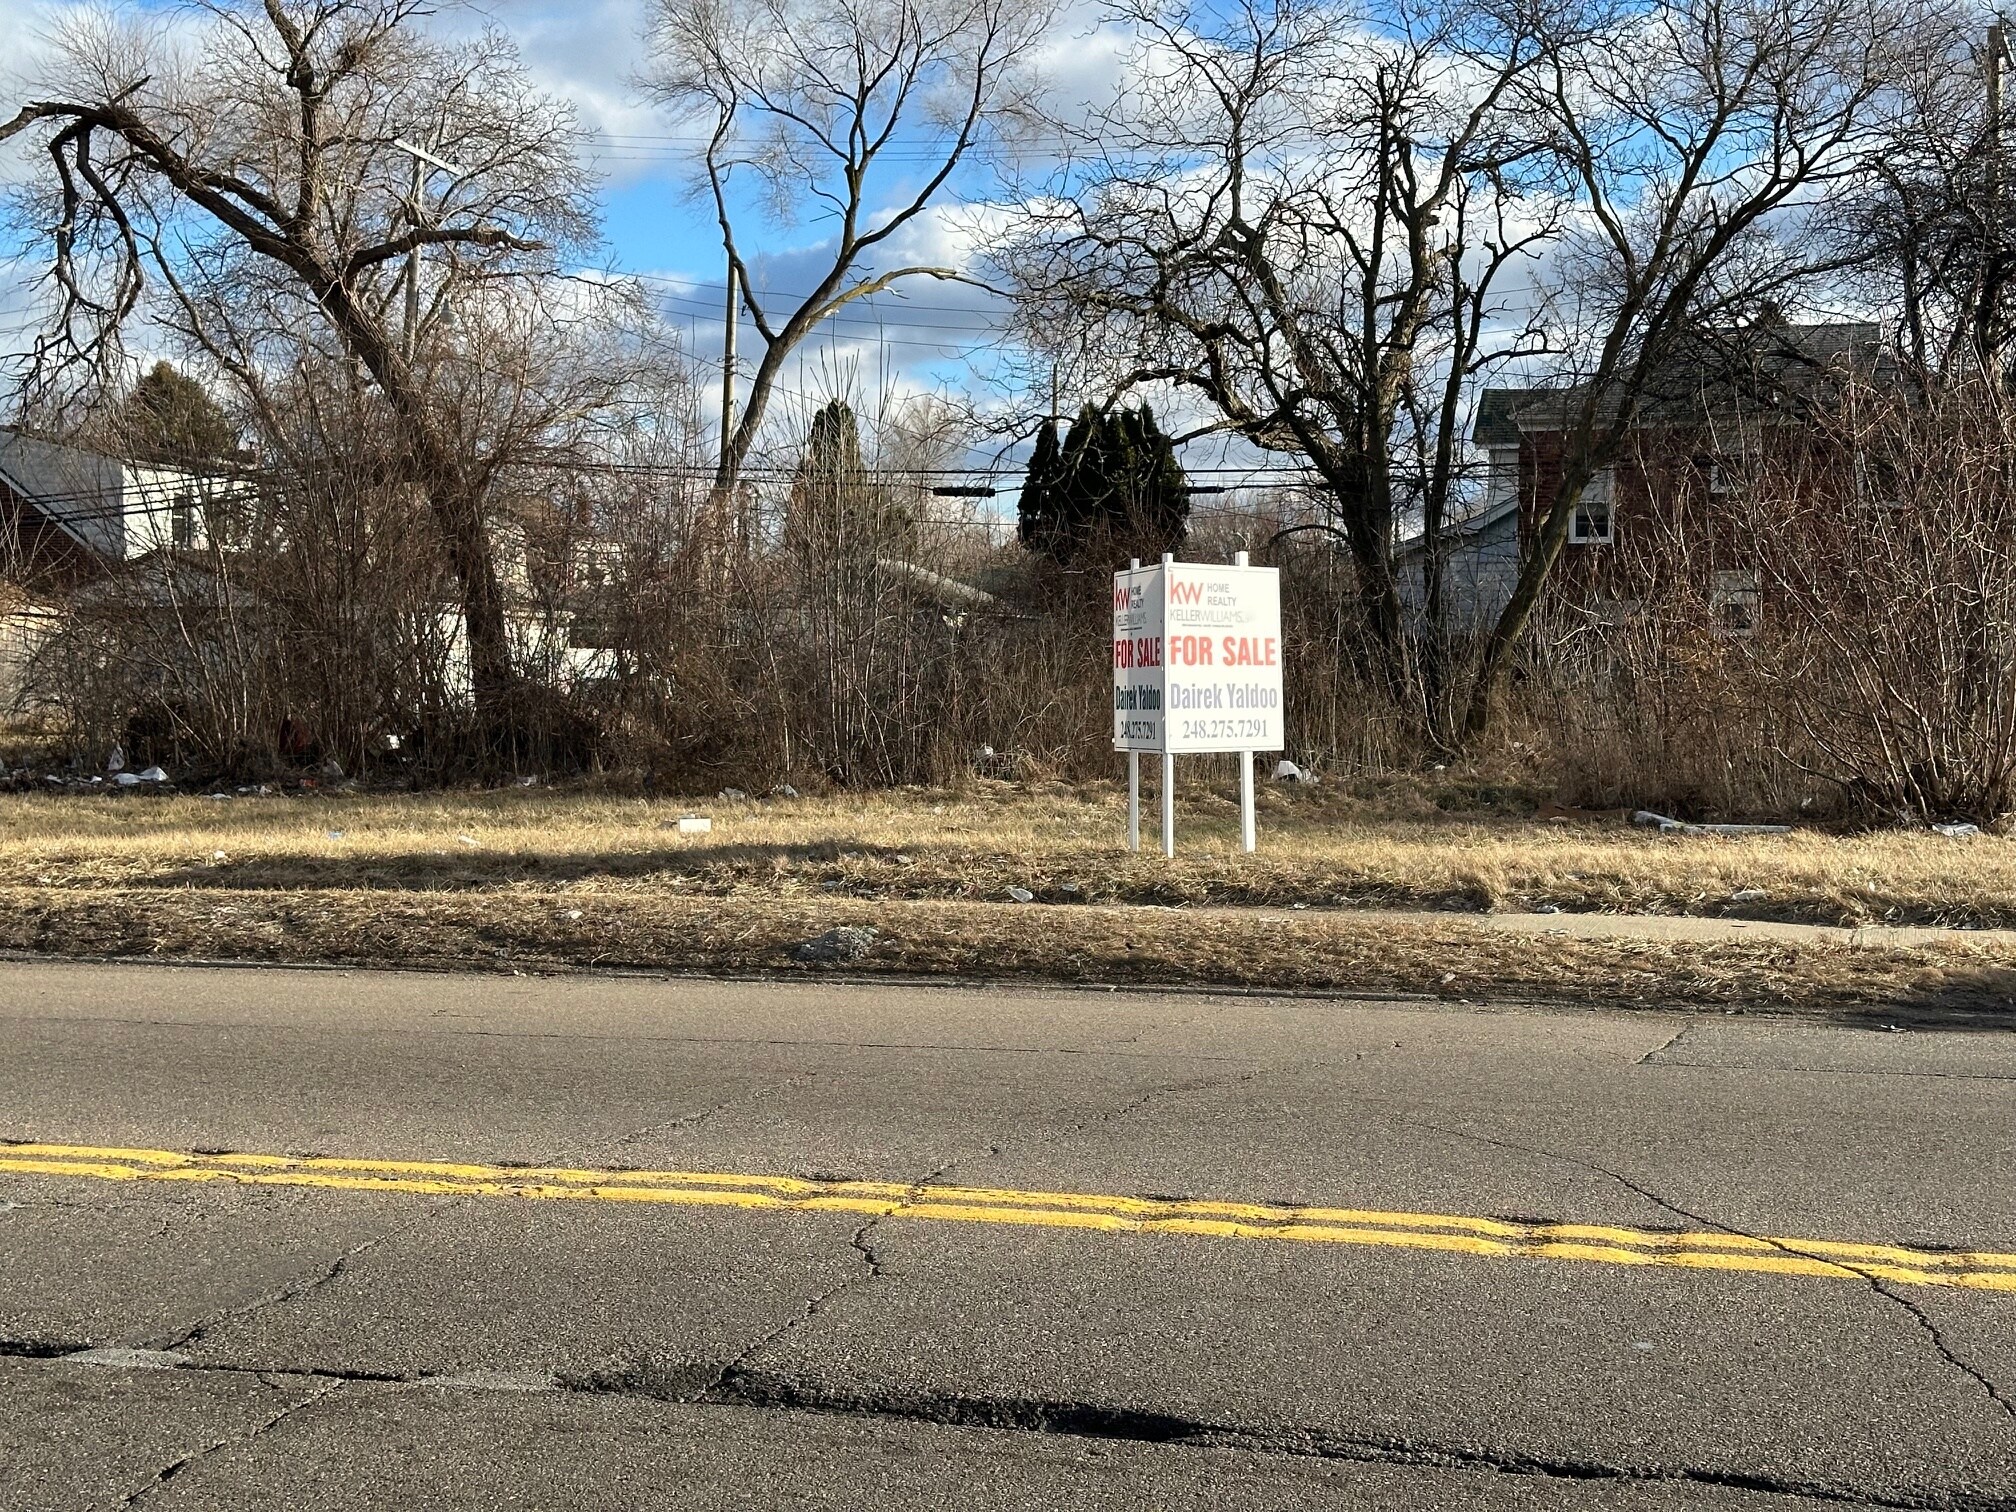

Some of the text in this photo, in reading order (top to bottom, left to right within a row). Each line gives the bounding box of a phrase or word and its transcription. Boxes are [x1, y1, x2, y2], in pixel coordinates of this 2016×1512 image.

[1207, 583, 1230, 593] HOME
[1207, 596, 1237, 607] REALTY
[1115, 637, 1161, 668] FOR SALE
[1170, 635, 1276, 667] FOR SALE
[1116, 684, 1161, 711] Dairek Yaldoo
[1170, 683, 1278, 710] Dairek Yaldoo
[1183, 719, 1268, 739] 248.275.7291
